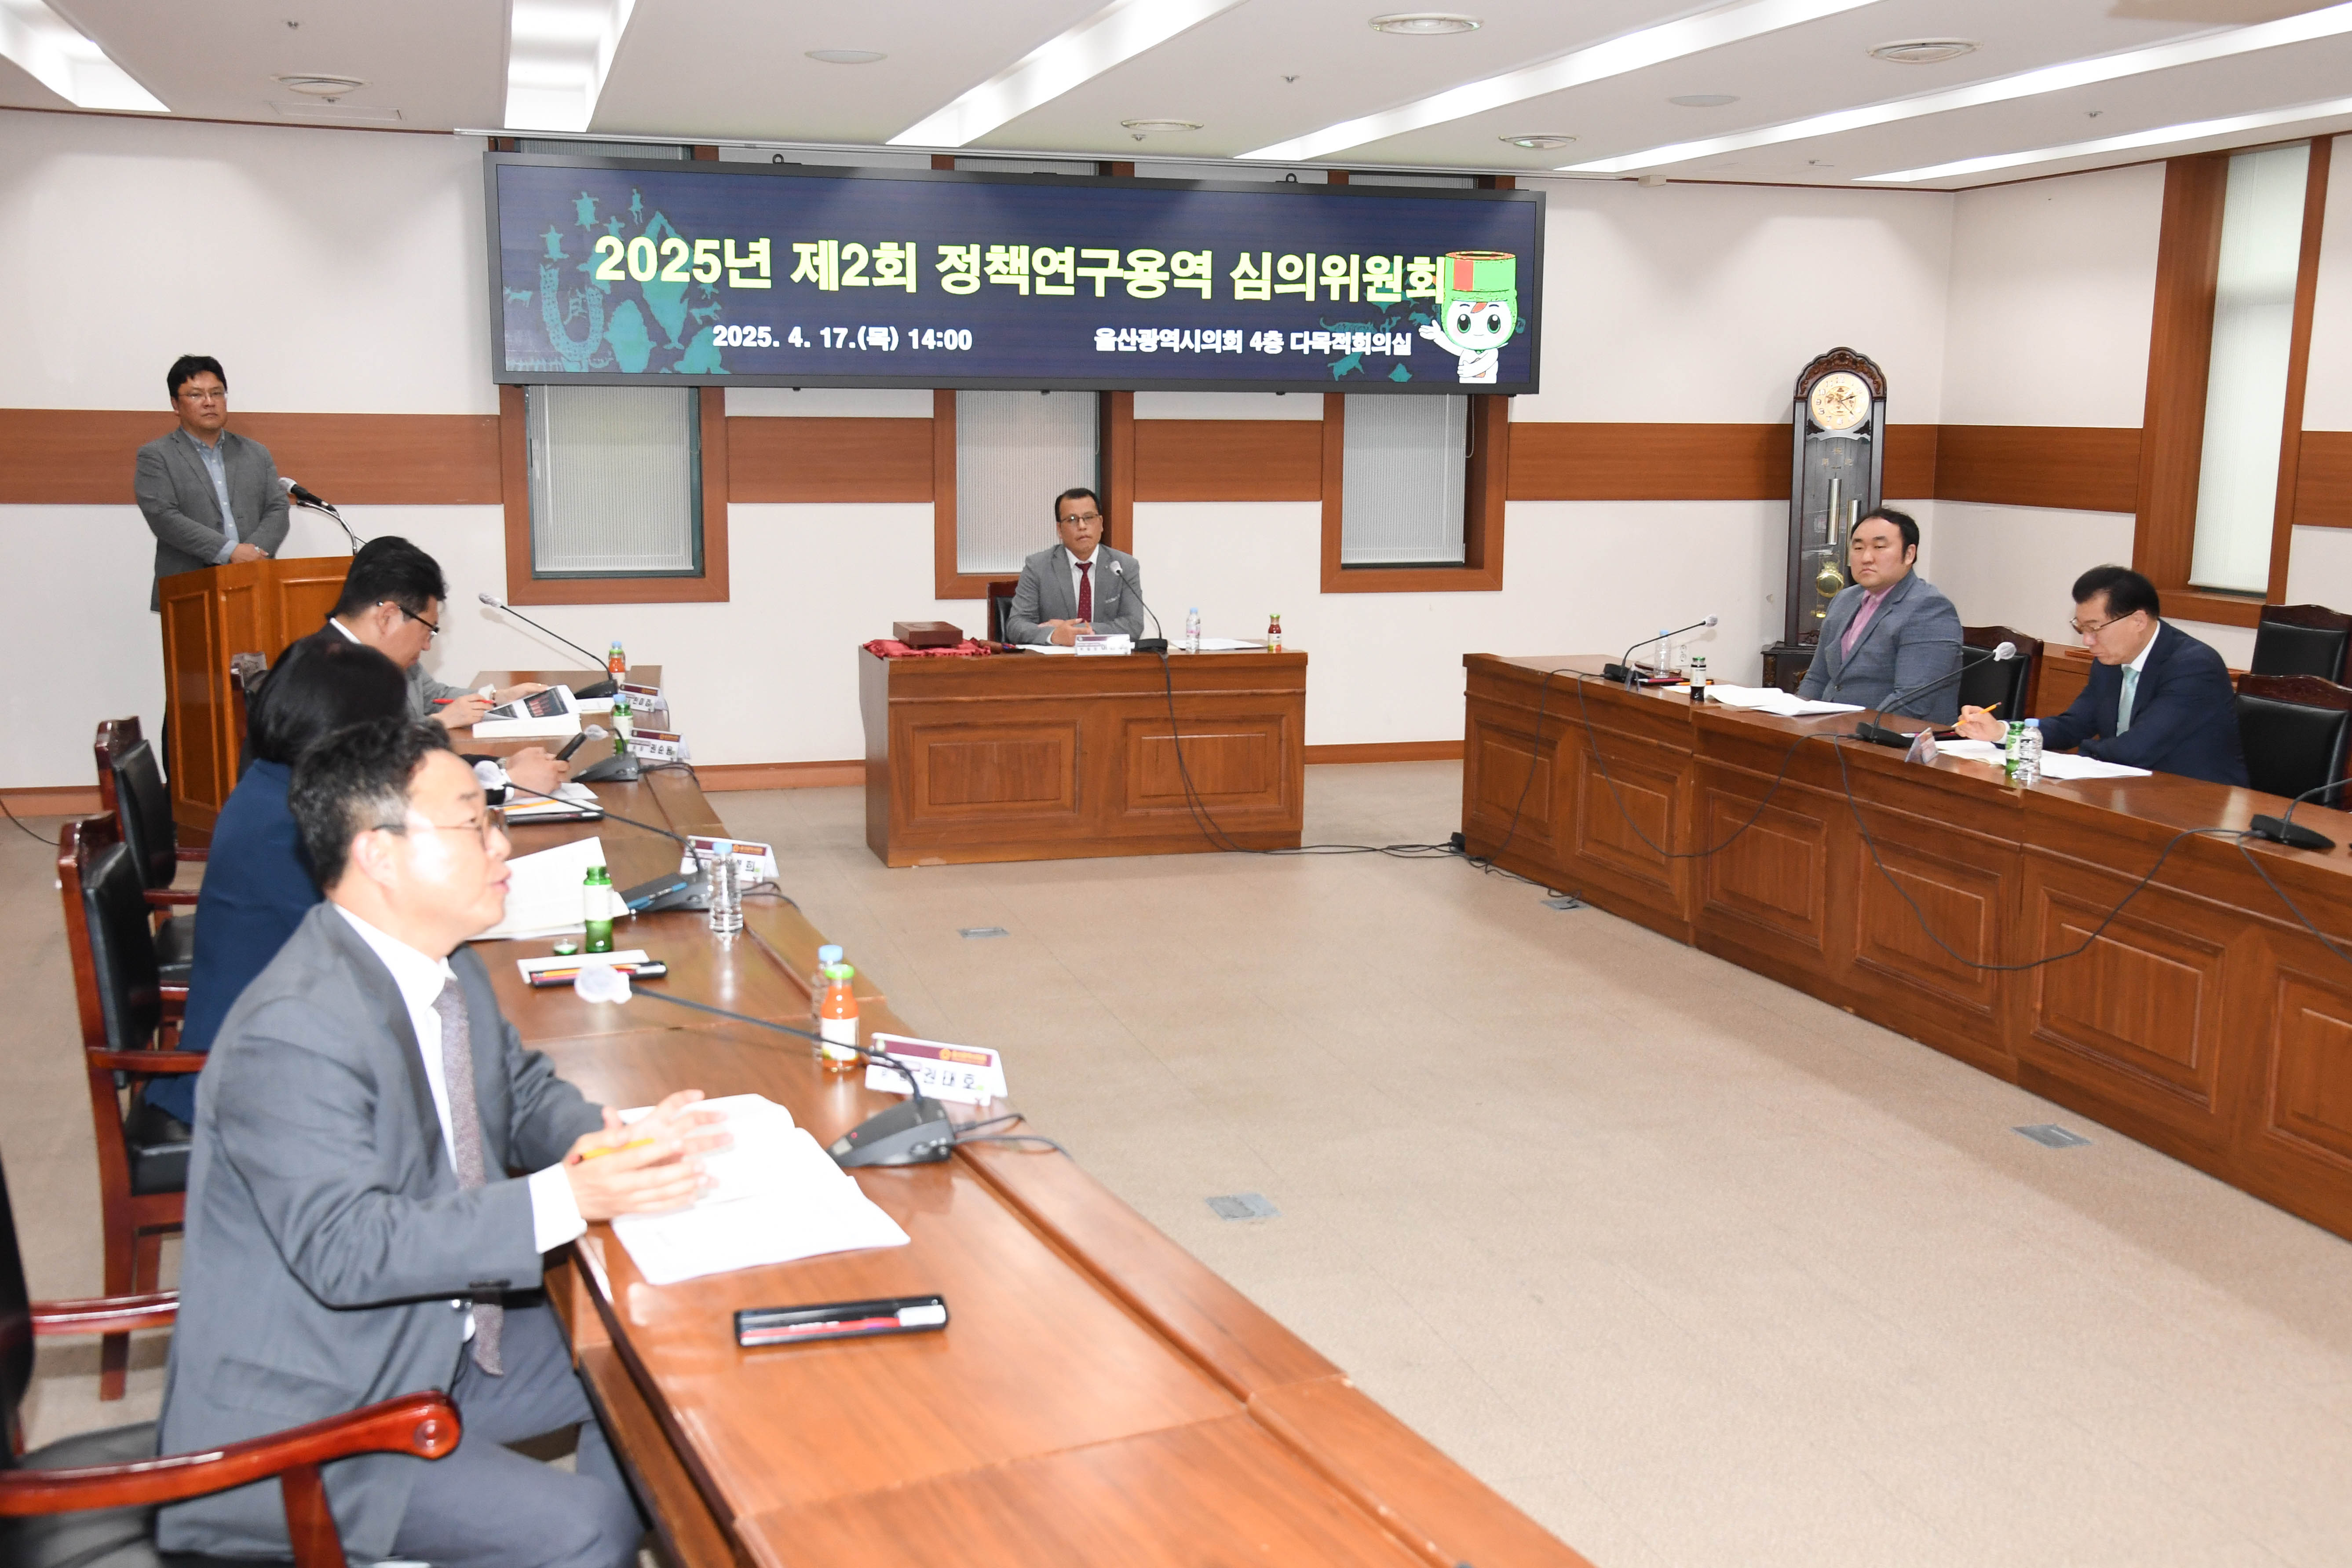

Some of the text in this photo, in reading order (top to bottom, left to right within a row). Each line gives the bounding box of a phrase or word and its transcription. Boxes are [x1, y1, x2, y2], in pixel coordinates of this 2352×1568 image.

[595, 235, 1445, 304] 2025년 제2회 정책연구용역 심의위원회
[712, 325, 972, 351] 2025. 4. 17.(목) 14:00
[1094, 327, 1411, 356] 울산광역시의회 4층 다목적회의실
